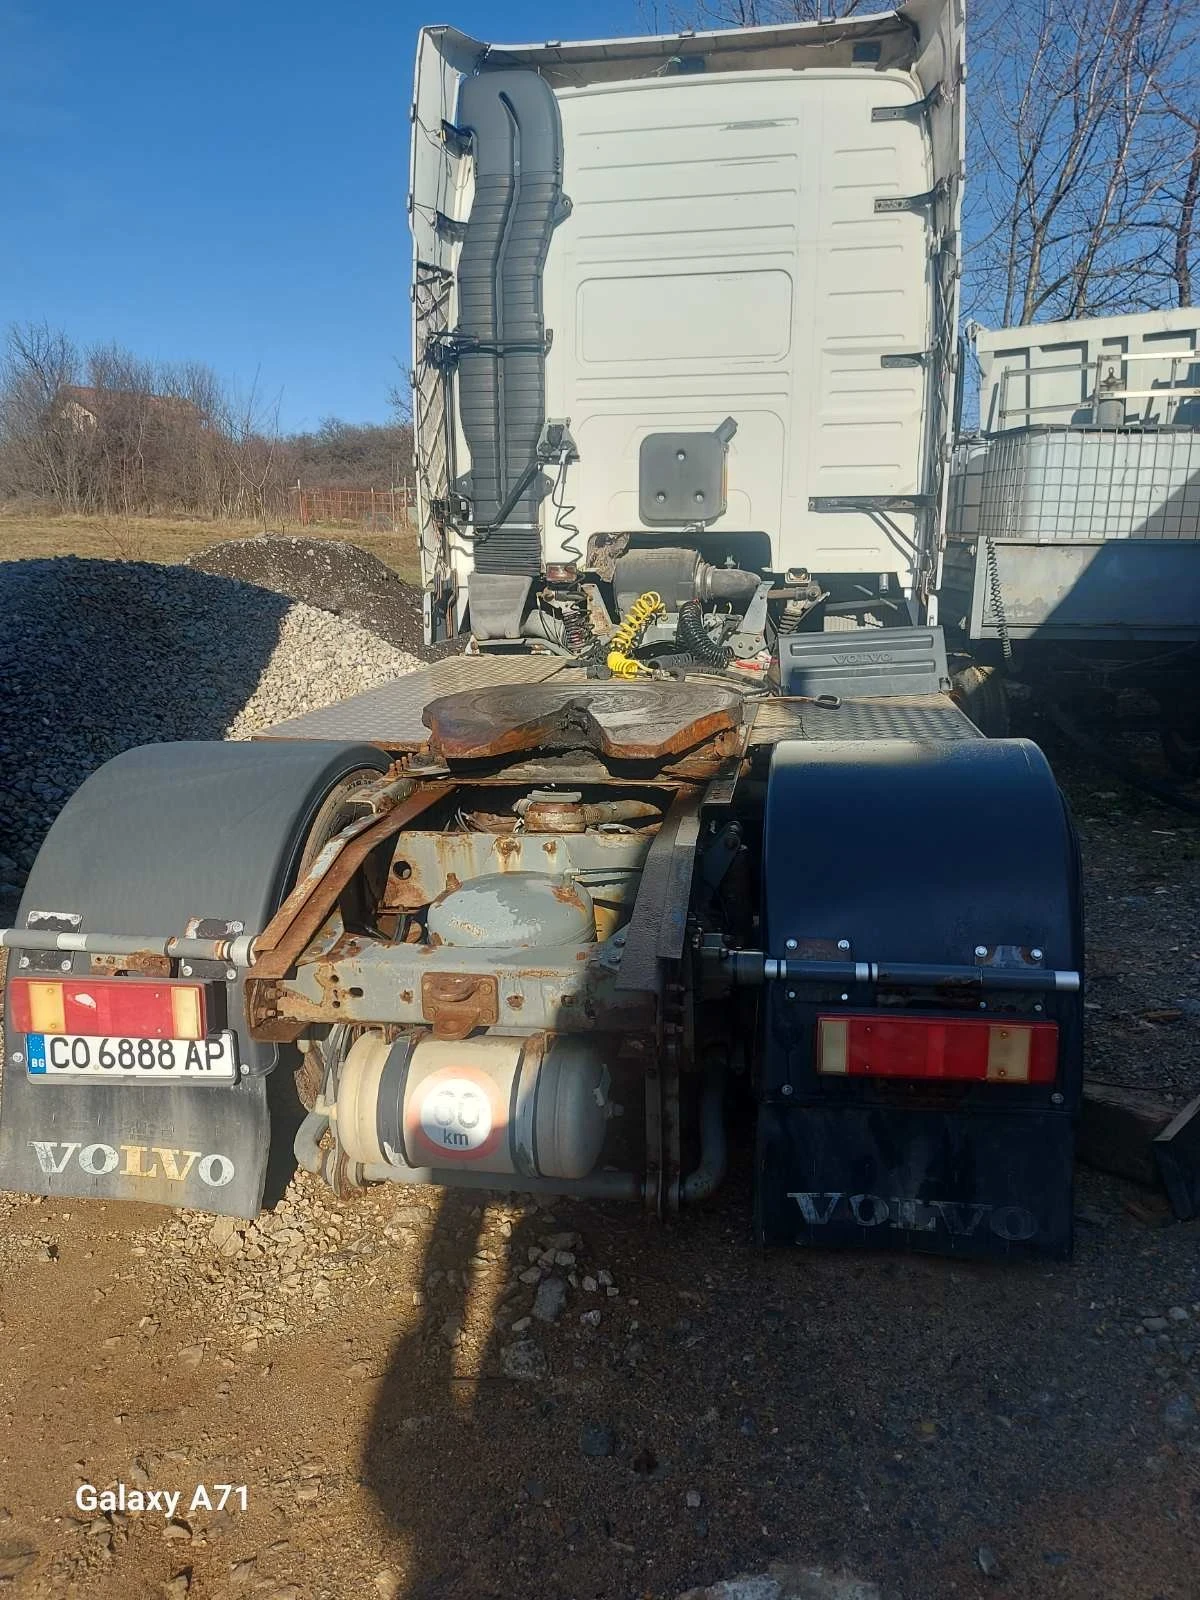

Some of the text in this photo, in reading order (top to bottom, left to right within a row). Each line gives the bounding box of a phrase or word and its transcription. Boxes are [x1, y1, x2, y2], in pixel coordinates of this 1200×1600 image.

[832, 653, 894, 665] VOLVO
[31, 1058, 45, 1068] BG
[98, 1038, 176, 1070] 6888
[184, 1039, 225, 1071] AP
[442, 1128, 470, 1146] km
[28, 1141, 235, 1187] VOLVO
[786, 1192, 1037, 1241] VOLVO
